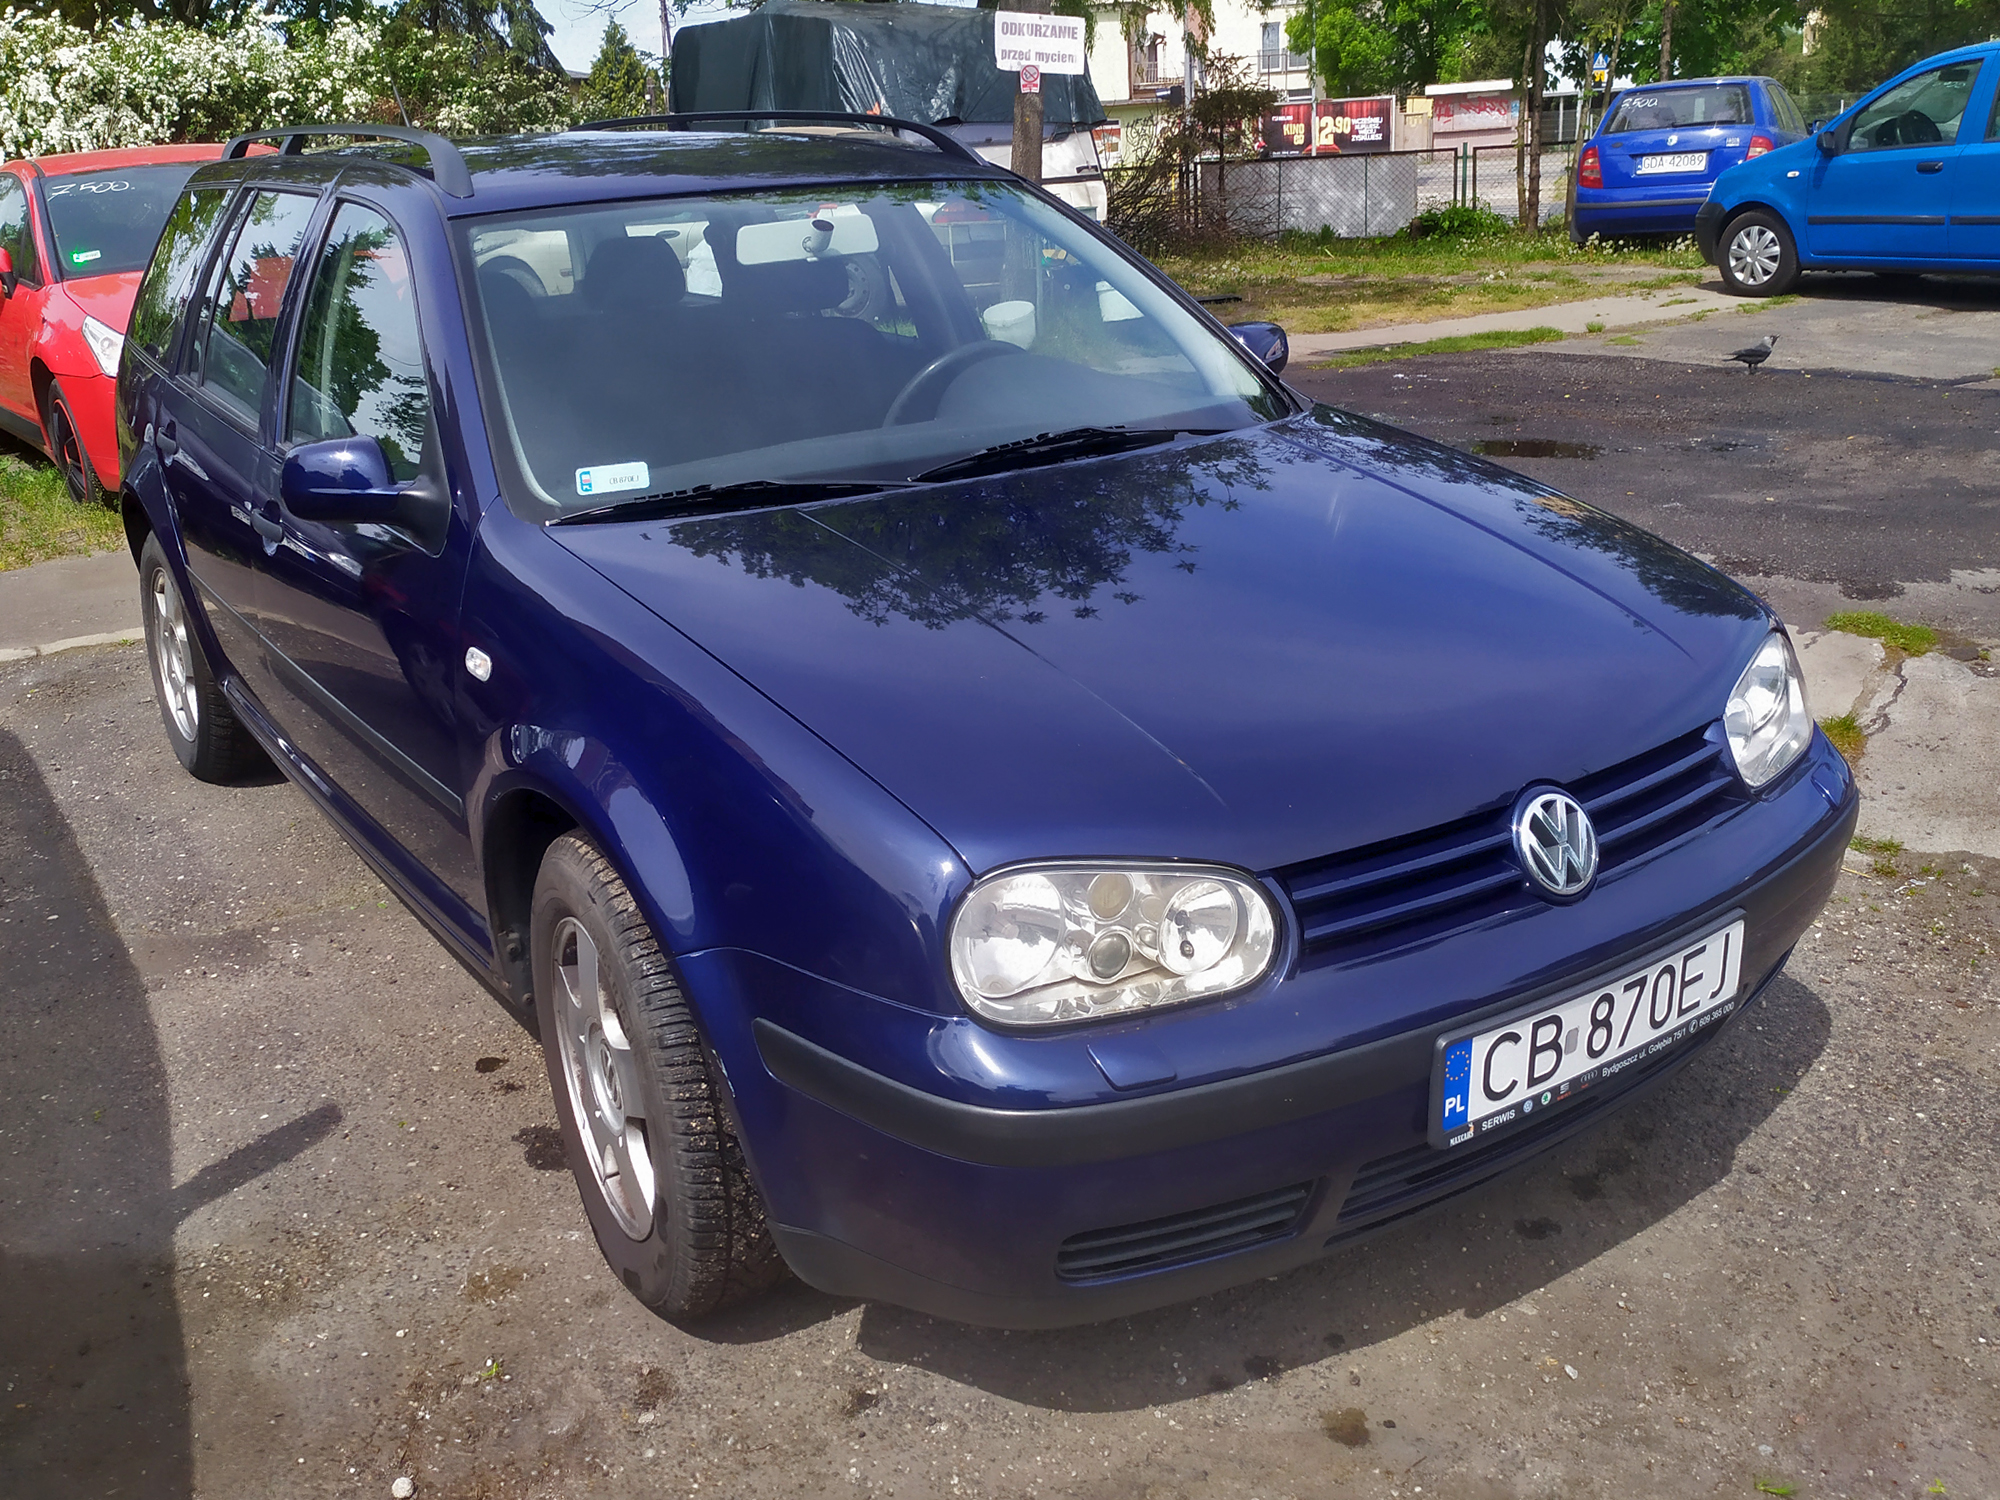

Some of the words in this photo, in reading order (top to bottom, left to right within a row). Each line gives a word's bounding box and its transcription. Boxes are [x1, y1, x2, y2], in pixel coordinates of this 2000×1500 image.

[1001, 21, 1079, 40] ODKURZANIE
[1001, 48, 1031, 61] przed
[1283, 123, 1305, 136] KINO
[1643, 156, 1664, 169] GDA
[1669, 154, 1704, 167] 42089
[1482, 1013, 1564, 1102] CB
[1585, 931, 1731, 1060] 870EJ
[1602, 1053, 1639, 1077] Bydgoszcz
[1673, 1027, 1687, 1040] 75/1
[1444, 1094, 1465, 1118] PL
[1481, 1109, 1516, 1131] SERWIS
